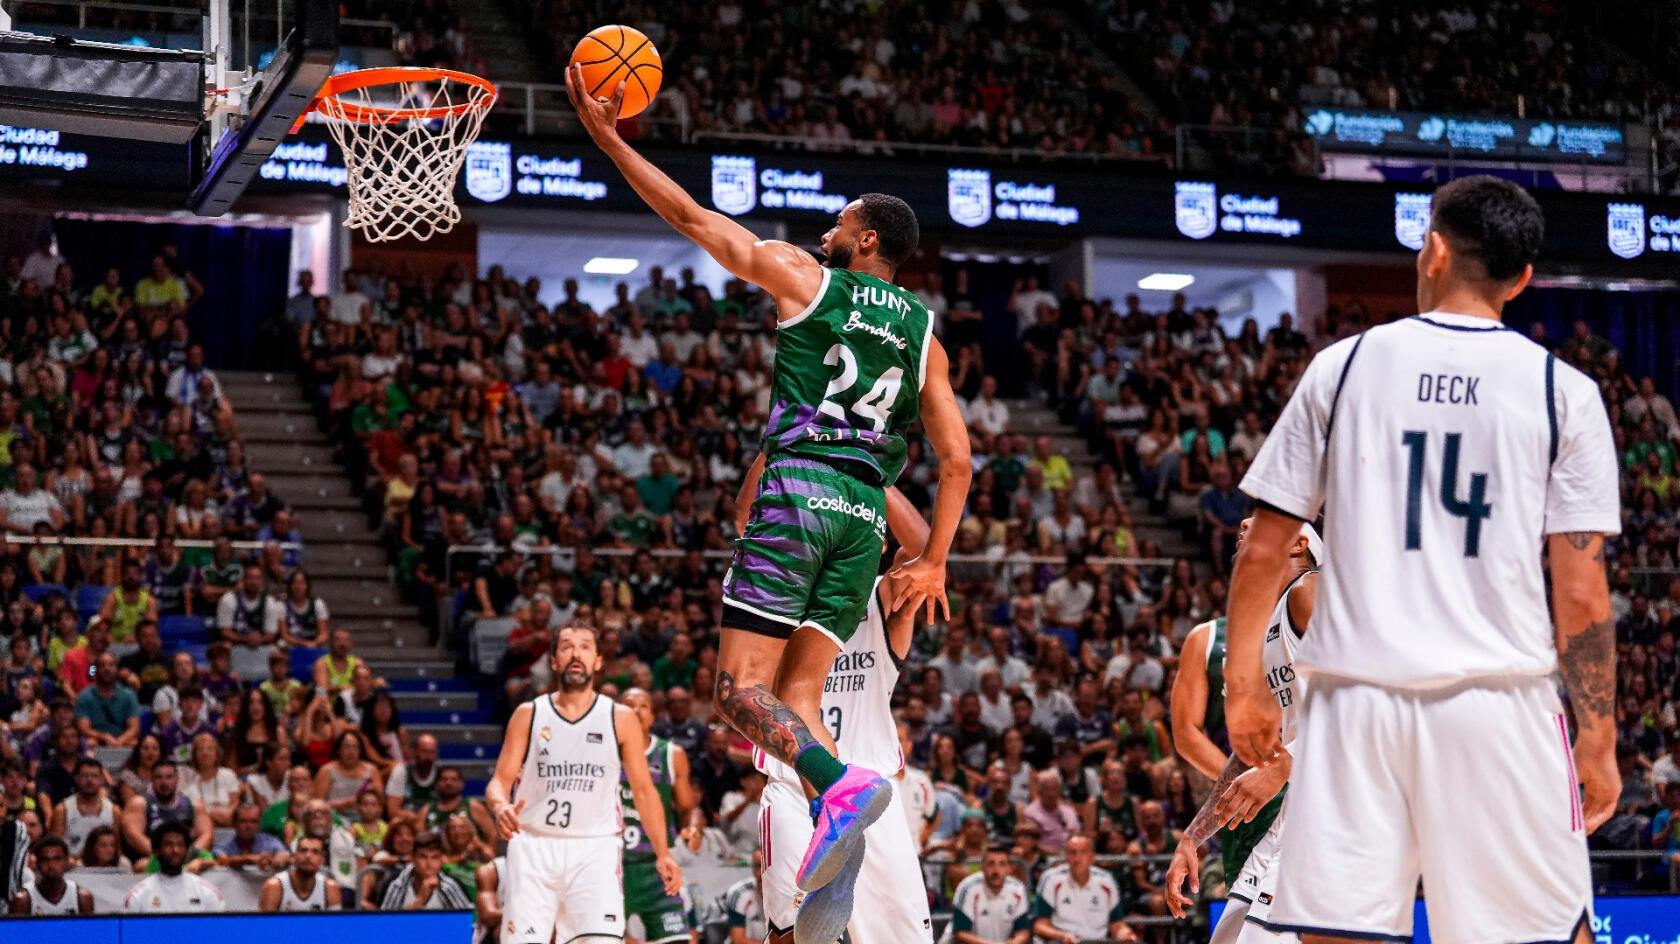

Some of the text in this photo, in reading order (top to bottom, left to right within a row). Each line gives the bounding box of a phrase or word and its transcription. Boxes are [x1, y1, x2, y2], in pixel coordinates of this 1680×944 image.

[19, 145, 88, 171] Málaga
[271, 142, 328, 162] iudad
[260, 160, 286, 180] de
[516, 154, 581, 178] Ciudad
[517, 175, 542, 195] de
[761, 168, 822, 191] Ciudad
[761, 188, 785, 208] de
[995, 181, 1055, 203] Ciudad
[995, 202, 1018, 220] de
[1221, 193, 1279, 215] Ciudad
[1221, 213, 1243, 232] de
[852, 285, 911, 321] HUNT
[814, 343, 904, 433] 24
[1417, 373, 1480, 406] DECK
[1401, 430, 1492, 558] 14
[834, 650, 876, 673] rates
[824, 673, 865, 693] BETTER
[537, 760, 605, 778] Emirates
[545, 798, 572, 829] 23
